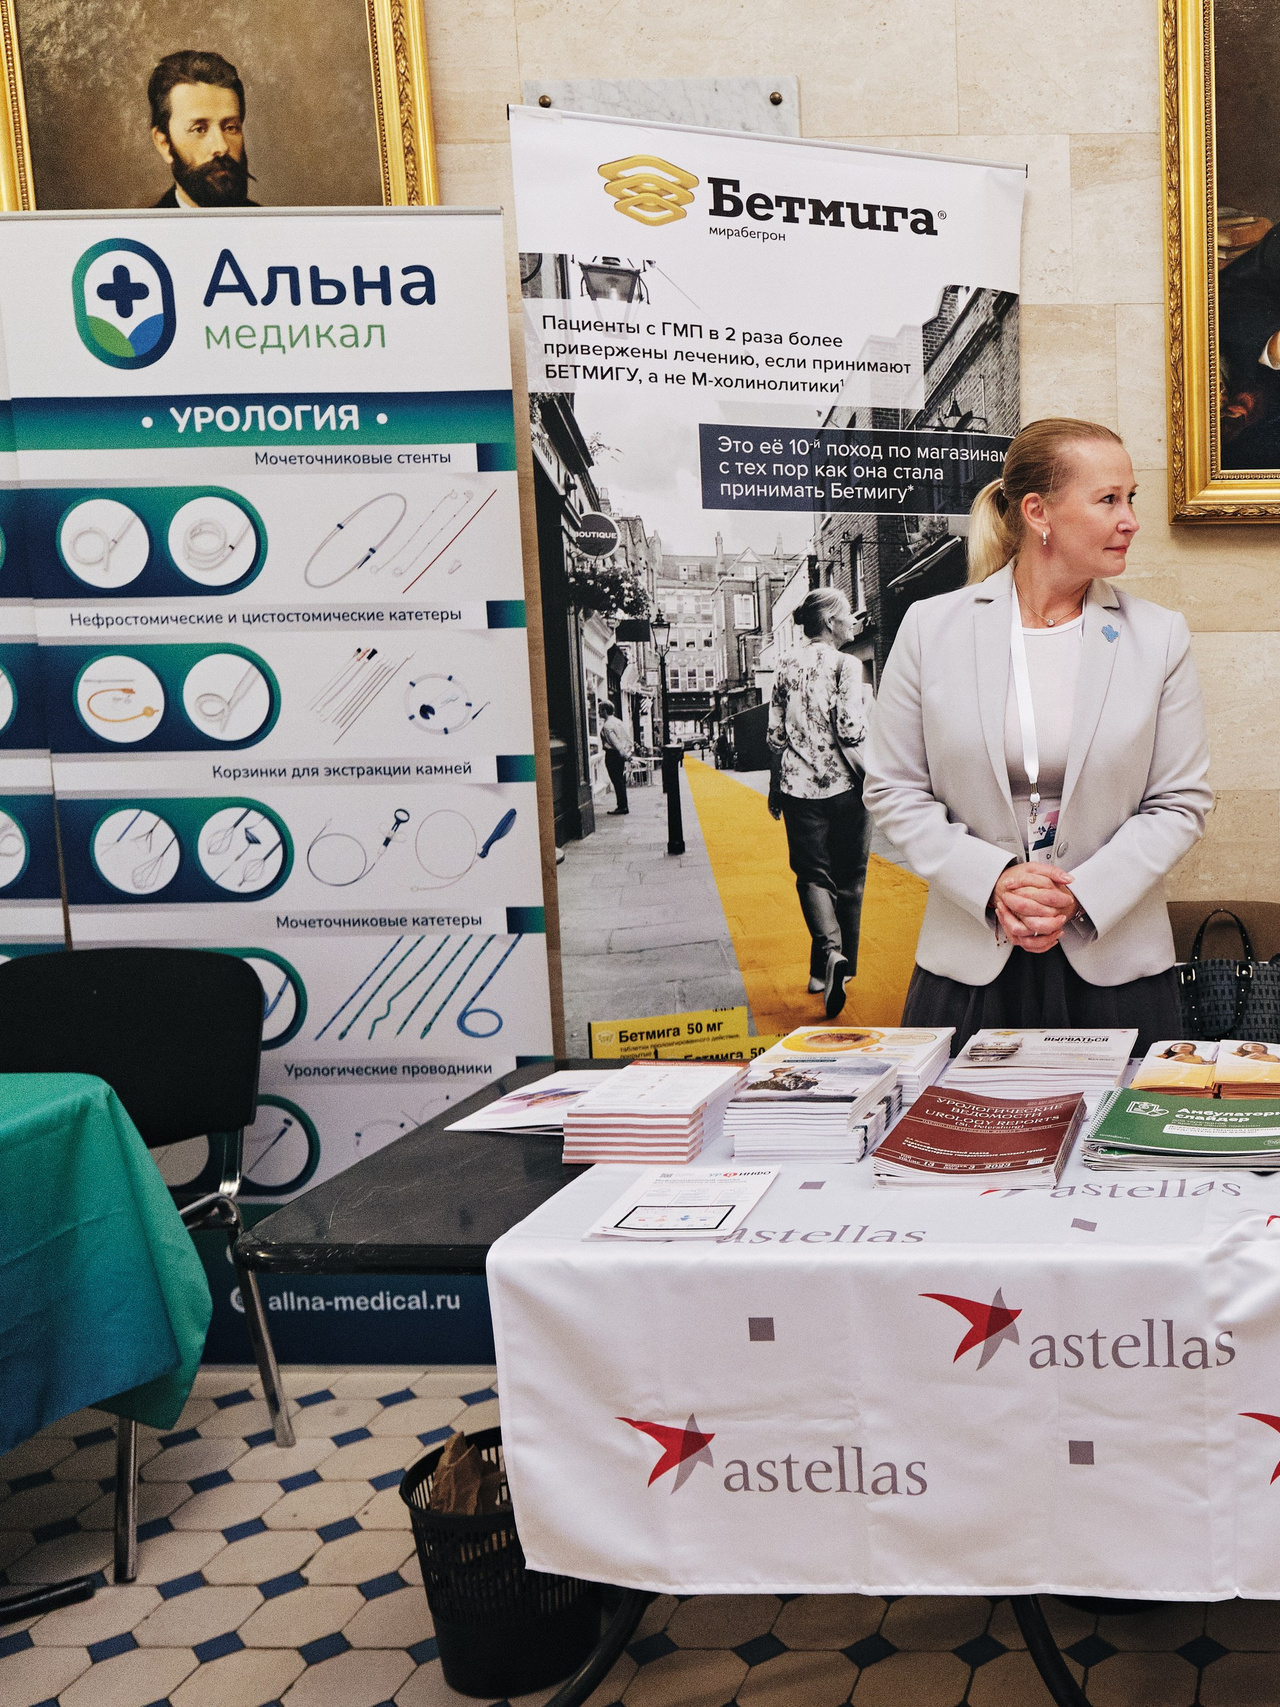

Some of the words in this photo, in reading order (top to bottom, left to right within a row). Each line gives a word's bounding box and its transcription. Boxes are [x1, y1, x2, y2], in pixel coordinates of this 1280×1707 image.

[709, 225, 786, 243] мирабегрон
[203, 248, 436, 307] Альна
[205, 323, 386, 354] медикал
[541, 315, 640, 336] Пациенты
[646, 325, 656, 335] с
[661, 322, 703, 339] ГМП
[709, 328, 719, 340] в
[725, 326, 736, 341] 2
[742, 329, 783, 345] раза
[788, 330, 843, 348] более
[544, 341, 668, 361] привержены
[672, 351, 759, 369] лечению,
[765, 356, 807, 369] если
[812, 358, 911, 375] принимают
[545, 364, 643, 385] БЕТМИГУ,
[648, 372, 659, 384] а
[663, 373, 686, 386] не
[170, 404, 360, 433] УРОЛОГИЯ
[717, 436, 754, 453] Это
[759, 437, 784, 455] её
[826, 442, 883, 460] поход
[888, 444, 911, 459] по
[255, 452, 392, 466] Мочеточниковые
[396, 452, 451, 466] стенты
[719, 461, 730, 474] с
[735, 461, 766, 475] тех
[772, 463, 809, 480] пор
[814, 463, 848, 478] как
[853, 465, 887, 479] она
[894, 466, 944, 481] стала
[720, 483, 824, 500] принимать
[70, 611, 224, 628] Нефростомические
[227, 613, 238, 624] и
[241, 610, 386, 626] цистостомические
[388, 608, 462, 625] катетеры
[211, 765, 287, 780] Корзинки
[290, 767, 320, 780] для
[323, 765, 412, 780] экстракции
[415, 760, 472, 776] камней
[276, 915, 408, 930] Мочеточниковые
[412, 914, 483, 929] катетеры
[619, 1025, 681, 1044] Бетмига
[686, 1021, 703, 1035] 50
[707, 1020, 724, 1033] мг
[284, 1063, 398, 1079] Урологические
[402, 1062, 493, 1078] проводники
[936, 1097, 1064, 1115] УРОЛОГИЧЕСКИЕ
[950, 1106, 1043, 1119] ВЕДОМОСТИ
[925, 1108, 995, 1126] UROLOGY
[996, 1114, 1060, 1126] REPORTS
[1175, 1114, 1250, 1124] слайдер
[1050, 1177, 1242, 1201] astellas
[268, 1289, 461, 1311] allna-medical.ru
[1030, 1319, 1236, 1370] astellas
[723, 1445, 928, 1496] astellas
